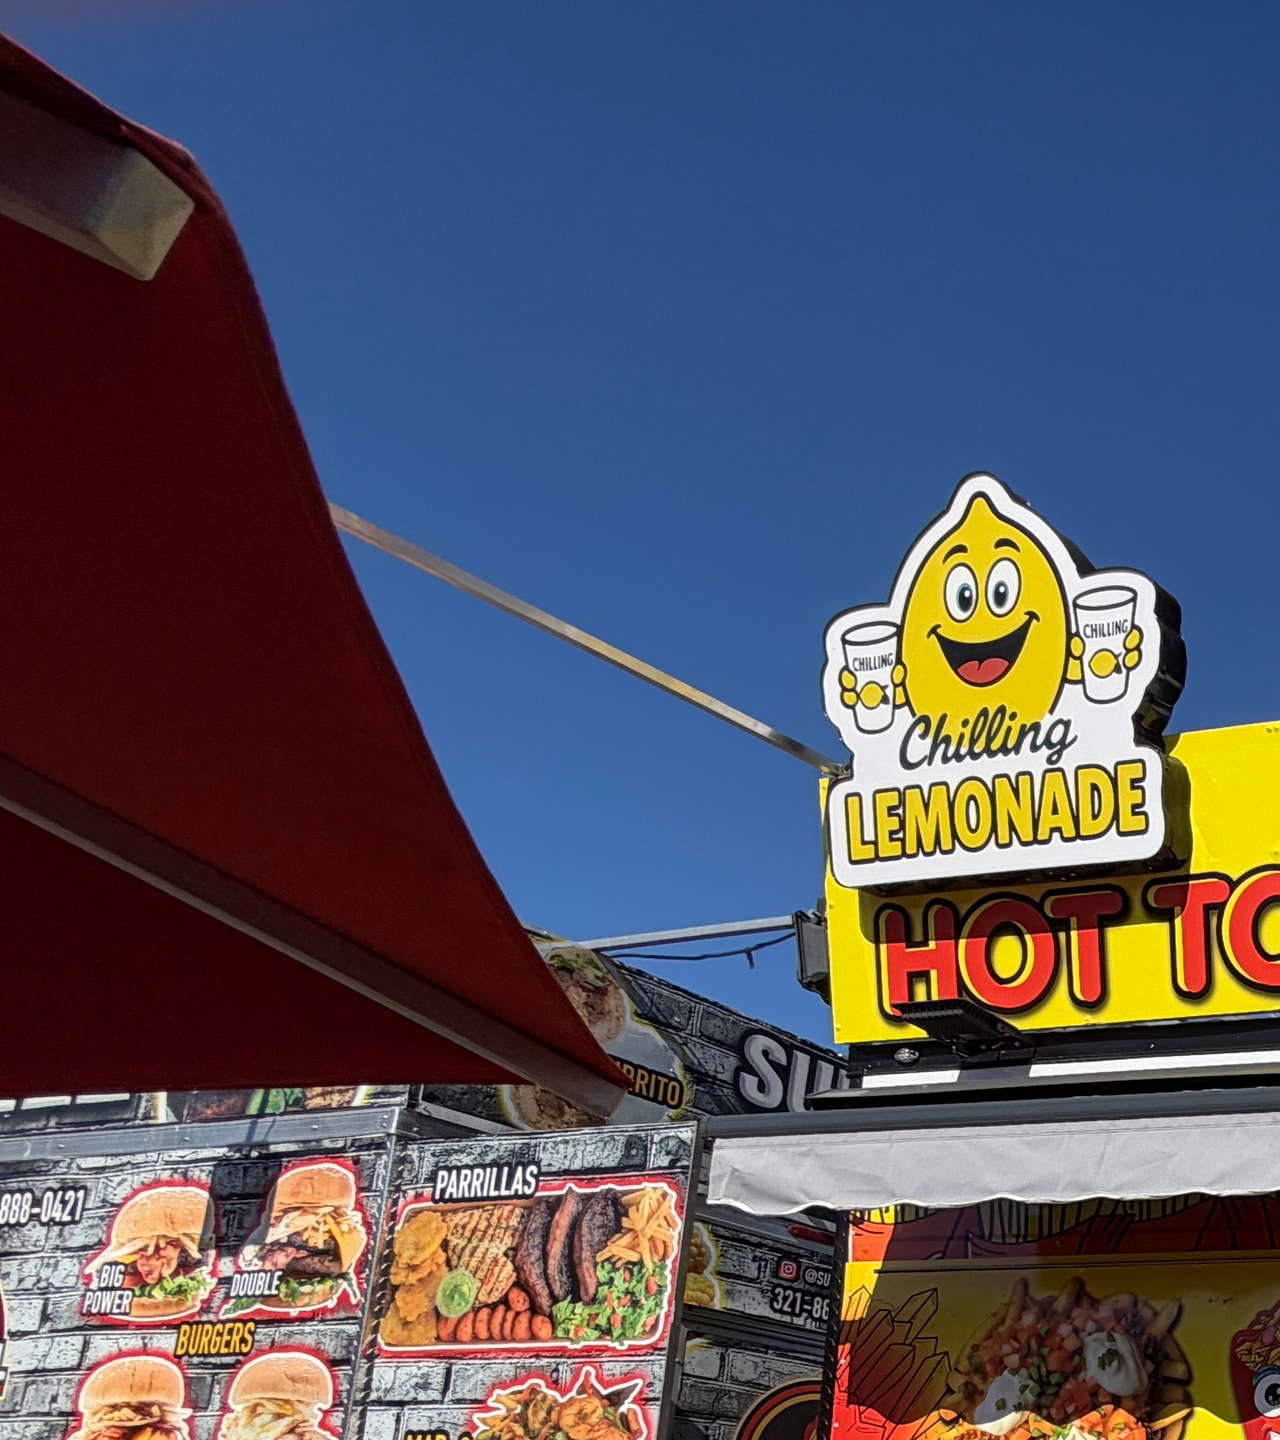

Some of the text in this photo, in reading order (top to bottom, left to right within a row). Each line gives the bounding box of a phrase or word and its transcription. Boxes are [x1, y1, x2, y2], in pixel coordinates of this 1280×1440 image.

[1083, 618, 1129, 640] CHILLING
[852, 653, 894, 672] CHILLING
[900, 706, 1078, 771] Chilling
[843, 759, 1148, 864] LEMONADE
[875, 888, 1127, 1024] HOT
[434, 1165, 538, 1199] PARRILLAS
[100, 1265, 124, 1287] BIG
[230, 1272, 283, 1297] DOUBLE
[83, 1291, 132, 1315] POWER
[176, 1322, 255, 1355] BURGERS
